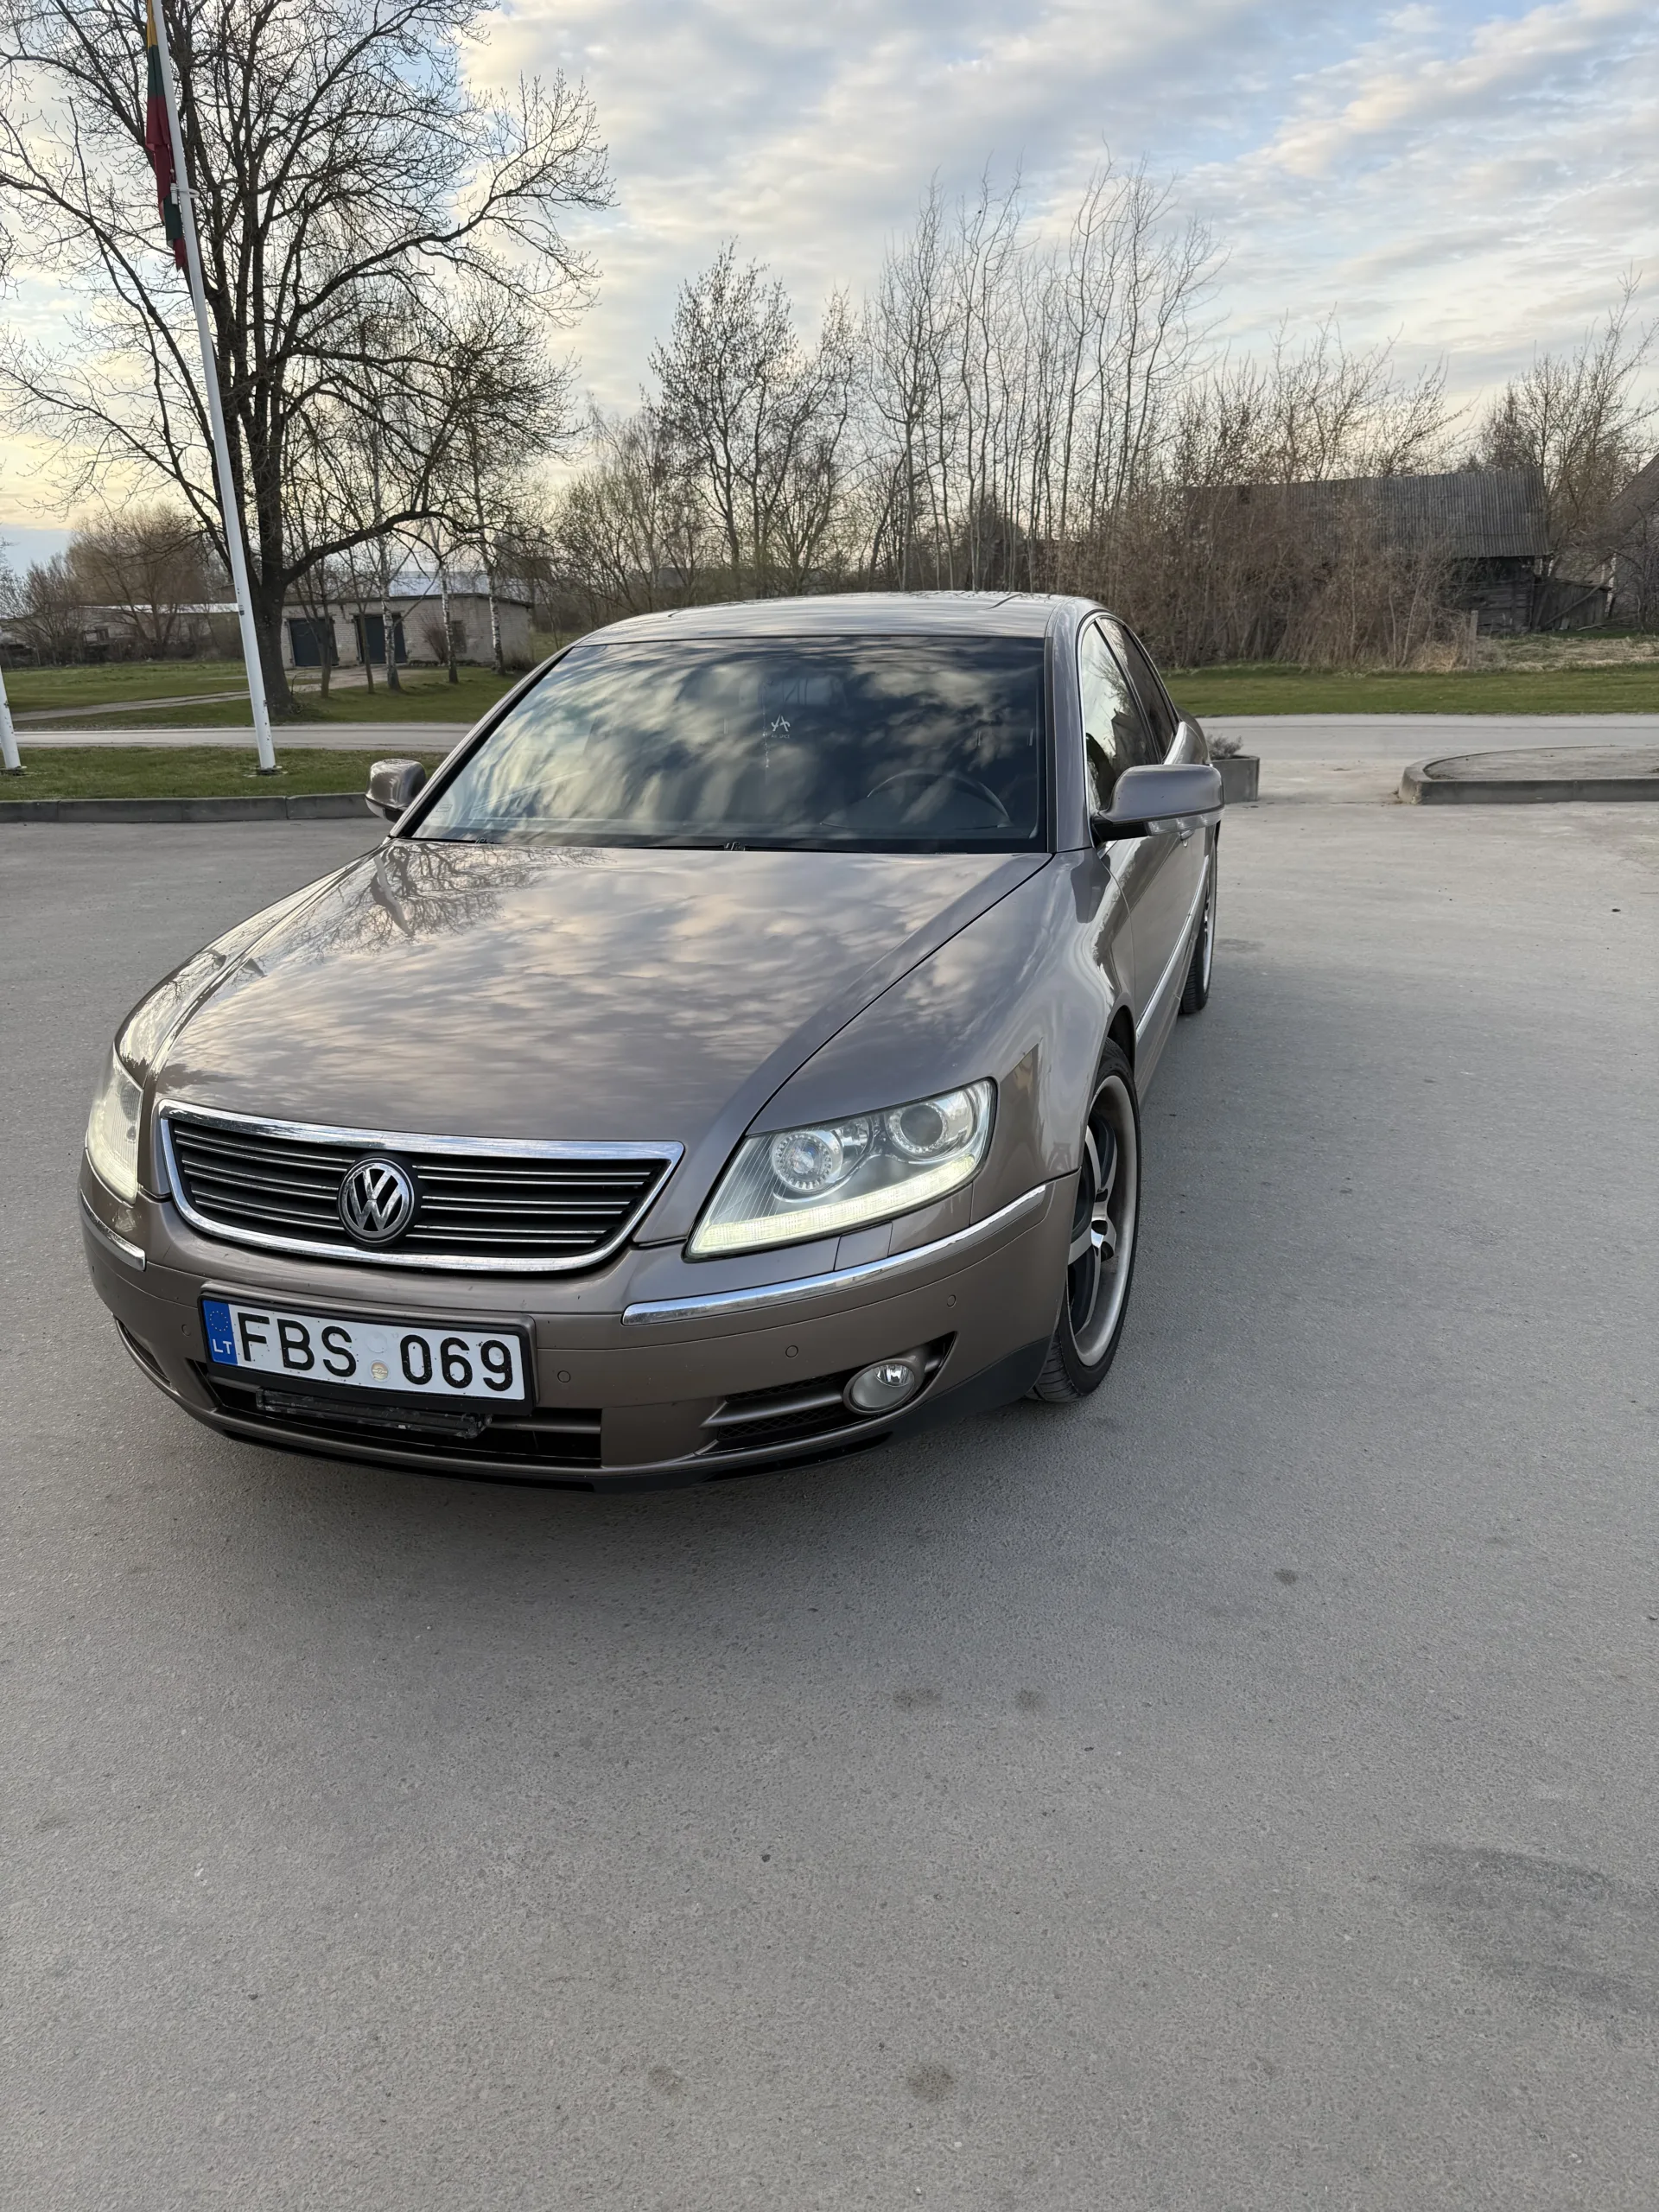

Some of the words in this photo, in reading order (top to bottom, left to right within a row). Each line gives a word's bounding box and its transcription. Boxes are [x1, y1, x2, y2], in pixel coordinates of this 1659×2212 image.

[341, 1161, 410, 1239] VW
[213, 1338, 232, 1355] LT
[237, 1312, 357, 1377] FBS
[399, 1334, 514, 1391] 069
